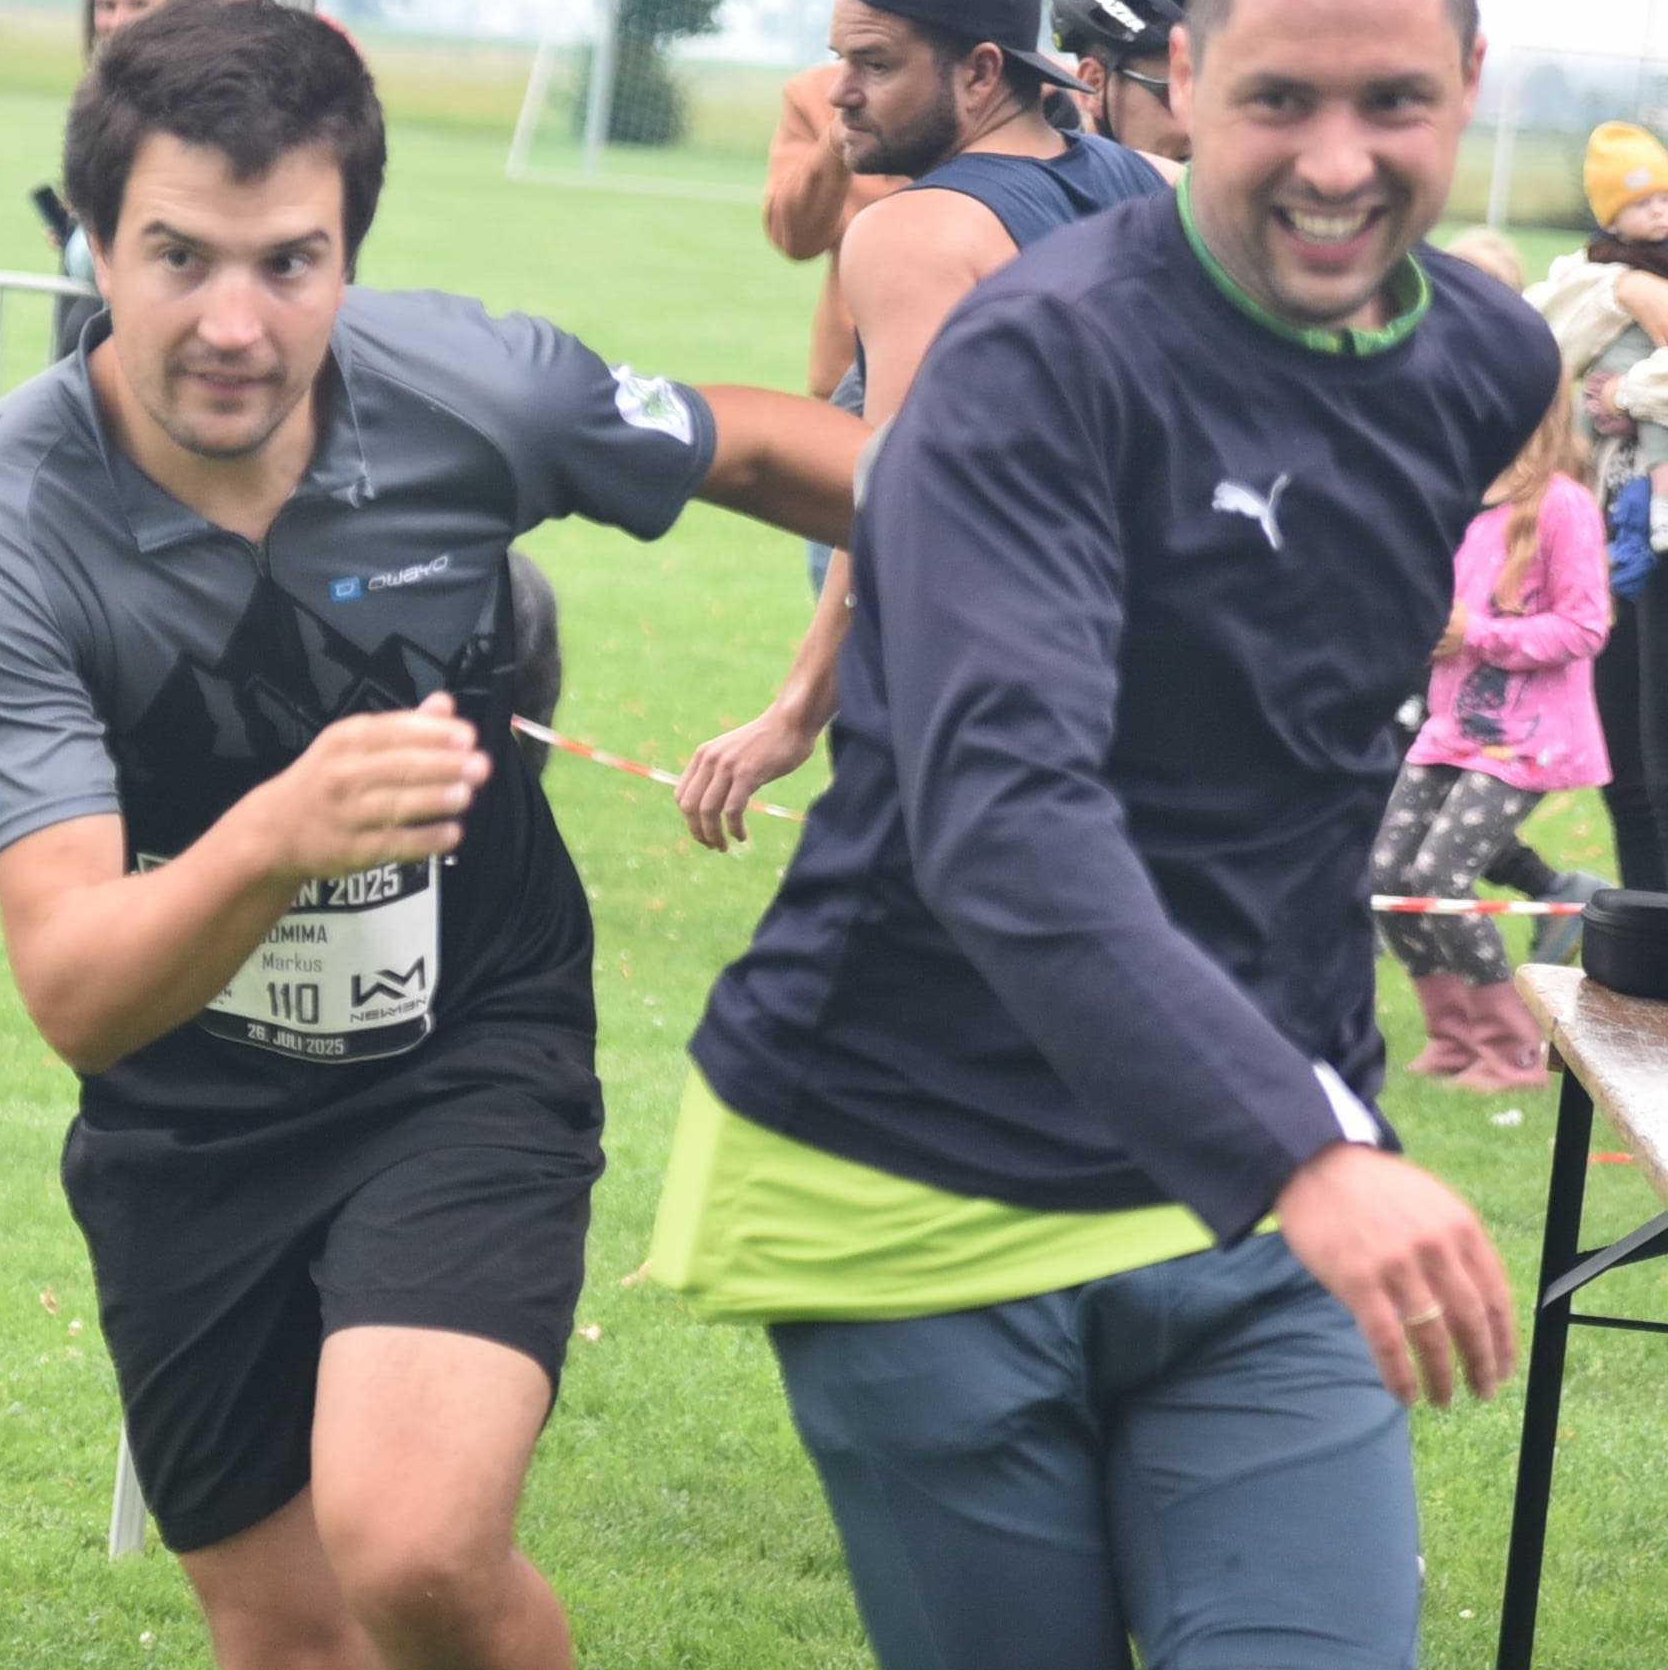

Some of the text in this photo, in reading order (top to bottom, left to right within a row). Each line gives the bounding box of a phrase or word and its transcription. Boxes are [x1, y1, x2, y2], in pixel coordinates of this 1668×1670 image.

[327, 862, 400, 907] 2025
[261, 923, 328, 944] OMIMA
[262, 950, 323, 972] Markus
[267, 981, 319, 1025] 110
[273, 1030, 303, 1052] JULI
[306, 1037, 345, 1056] 2025
